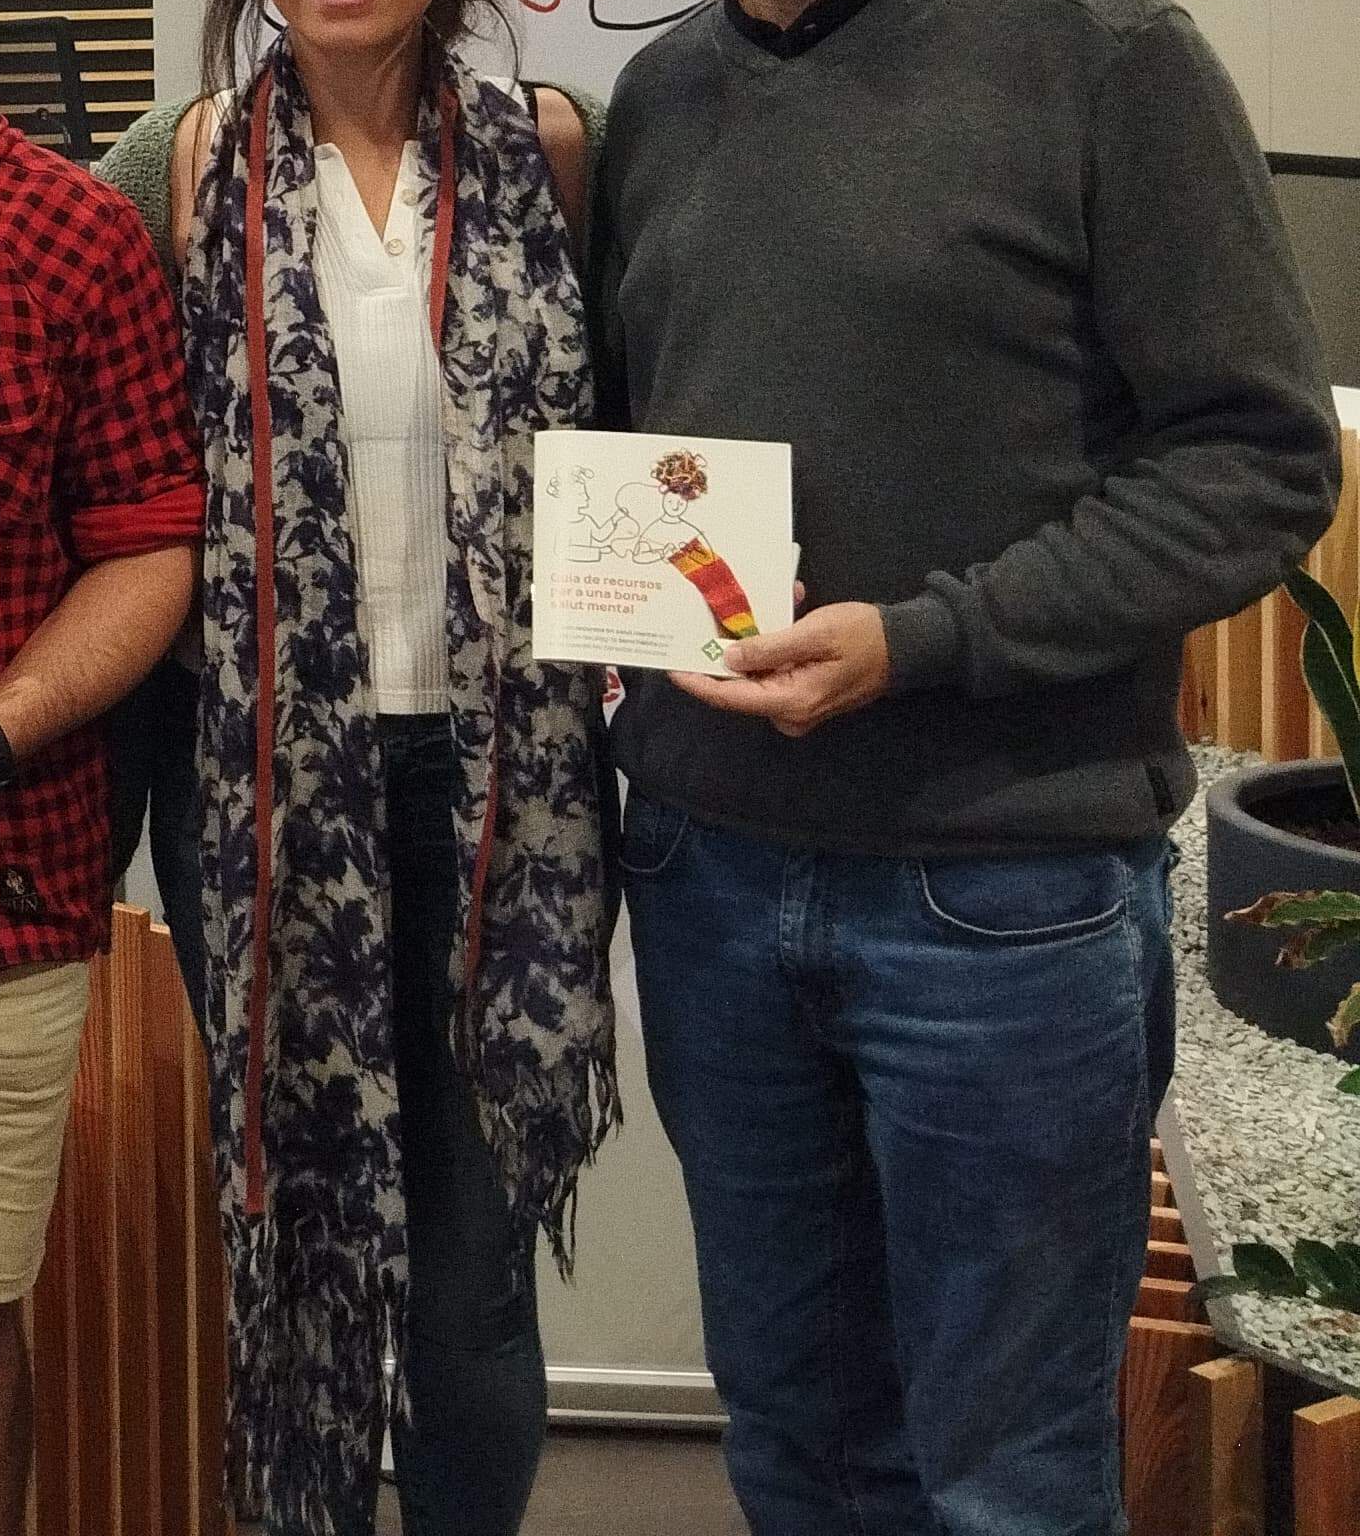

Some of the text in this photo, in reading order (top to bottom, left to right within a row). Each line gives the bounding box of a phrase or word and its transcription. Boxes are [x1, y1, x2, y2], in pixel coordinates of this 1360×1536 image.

[584, 574, 600, 584] de
[603, 577, 662, 590] recursos
[586, 589, 611, 600] una
[614, 589, 648, 602] bona
[587, 601, 634, 614] mental
